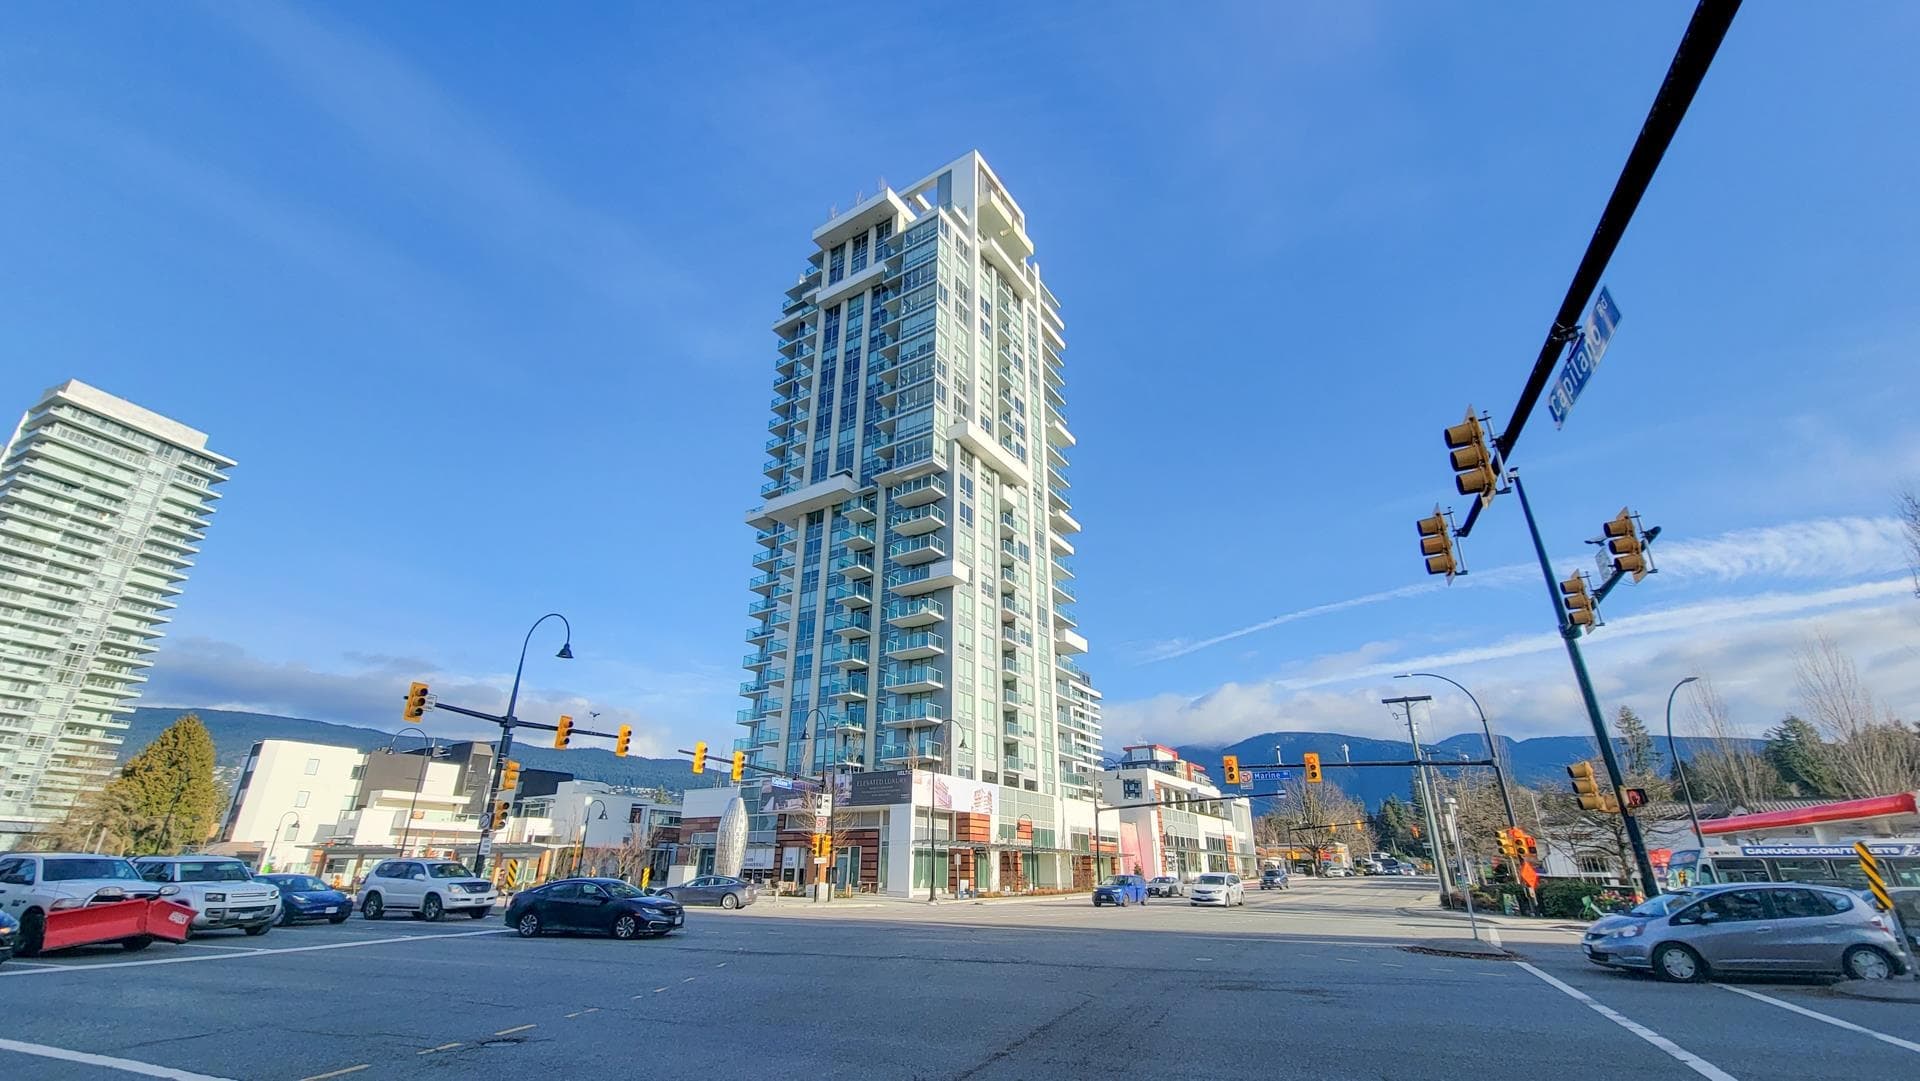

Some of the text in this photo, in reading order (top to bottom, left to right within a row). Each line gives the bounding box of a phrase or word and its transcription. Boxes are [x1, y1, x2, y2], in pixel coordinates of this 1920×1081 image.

[1550, 295, 1608, 417] Capilano Rd
[1745, 847, 1900, 855] CANUCKS.COM/TIKETS
